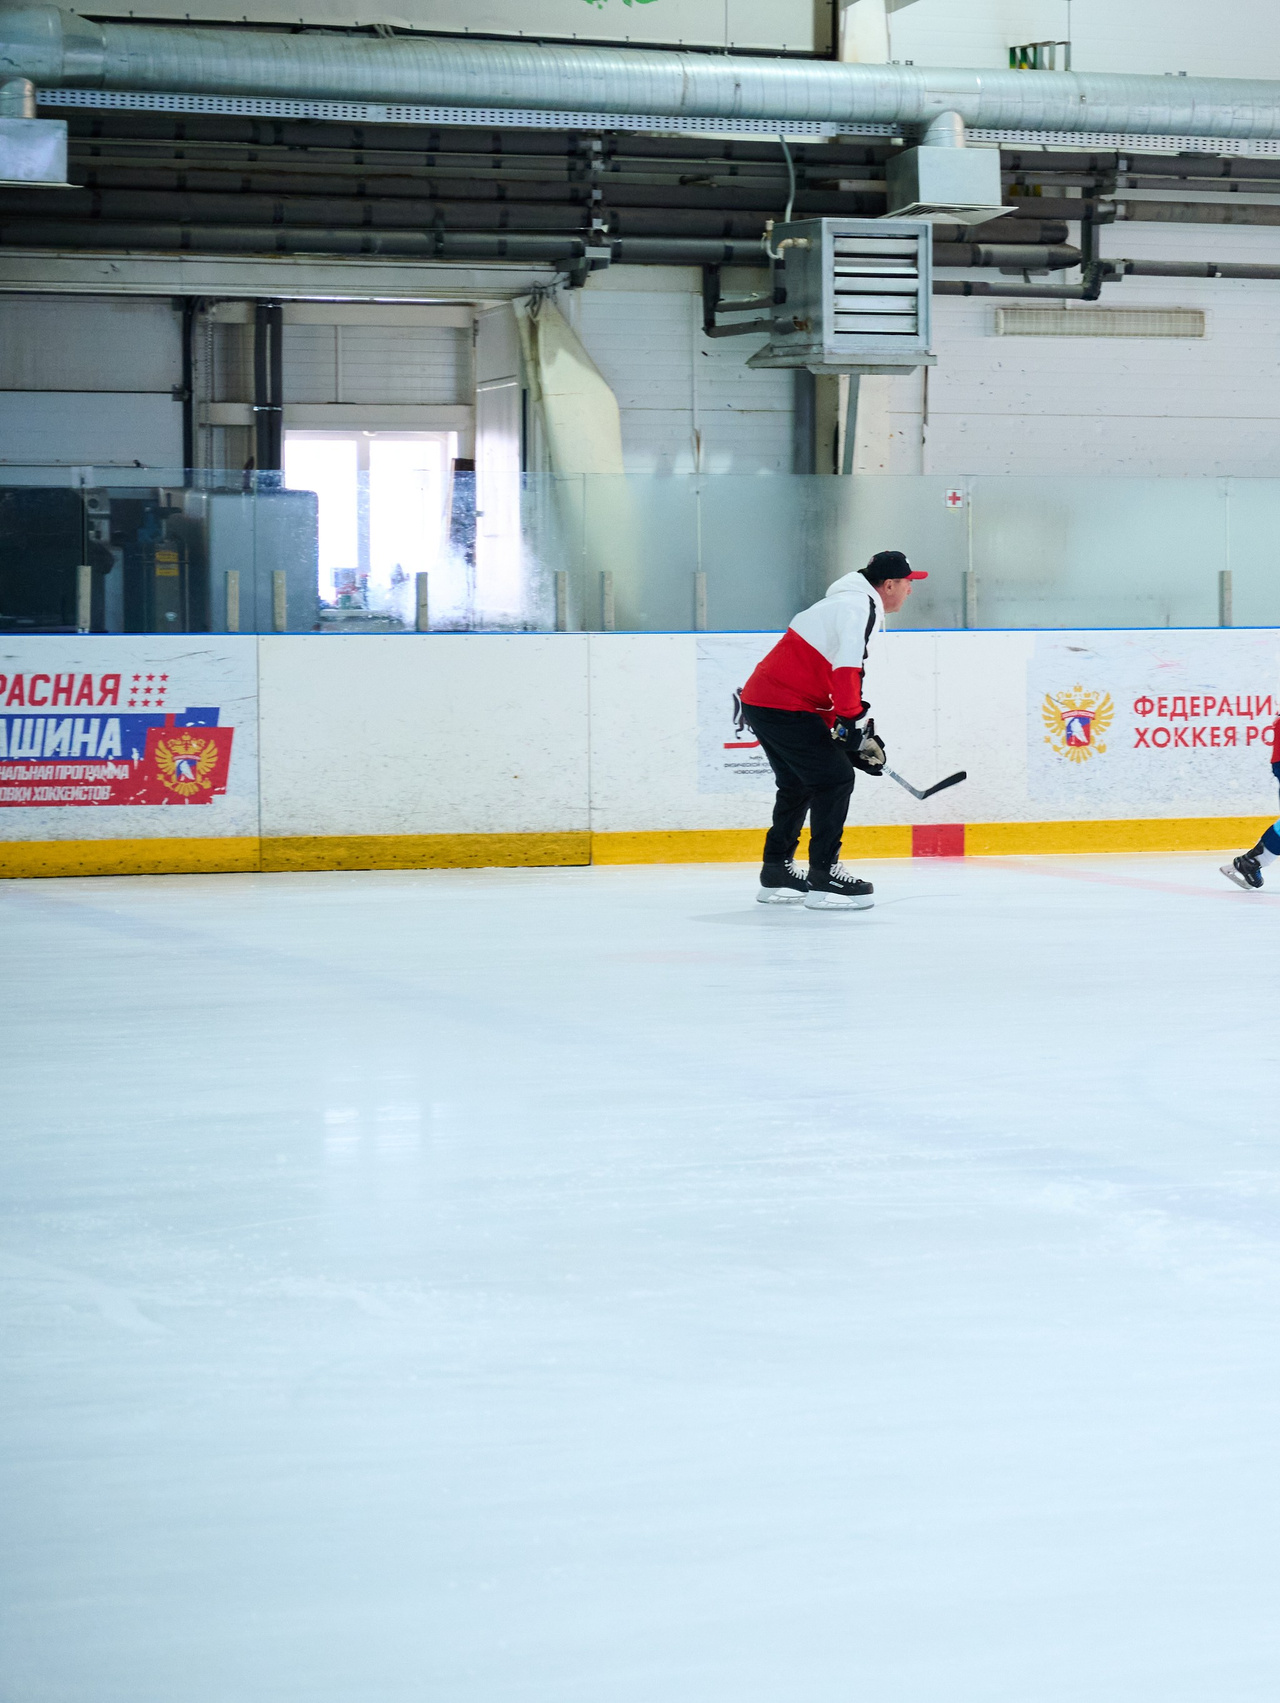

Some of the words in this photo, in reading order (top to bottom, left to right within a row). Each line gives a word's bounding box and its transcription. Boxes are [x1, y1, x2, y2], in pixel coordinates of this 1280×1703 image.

[1133, 726, 1238, 749] ХОККЕЯ
[54, 764, 129, 780] ПРОГРАММА
[32, 785, 112, 801] ХОККЕИСТОВ
